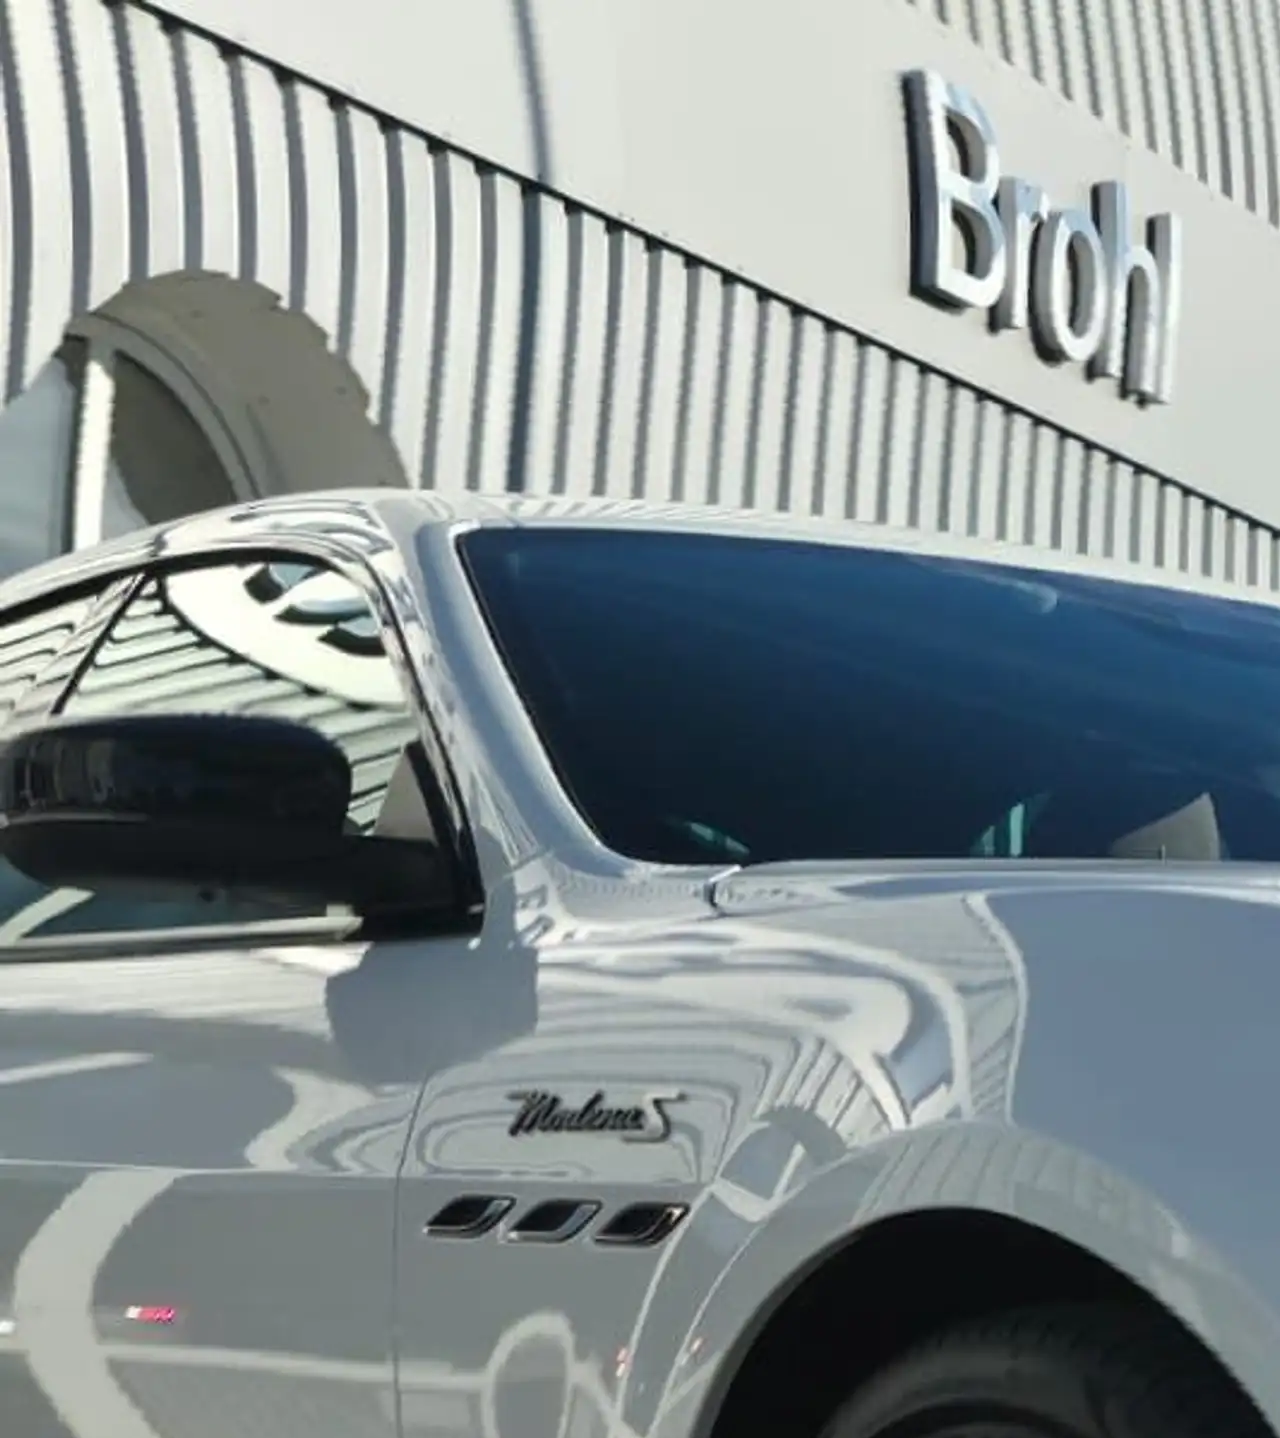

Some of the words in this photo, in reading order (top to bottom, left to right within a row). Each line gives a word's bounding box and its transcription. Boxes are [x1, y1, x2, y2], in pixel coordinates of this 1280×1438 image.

[904, 69, 1181, 407] Brohl
[506, 1089, 645, 1138] Modena
[620, 1089, 688, 1143] S
